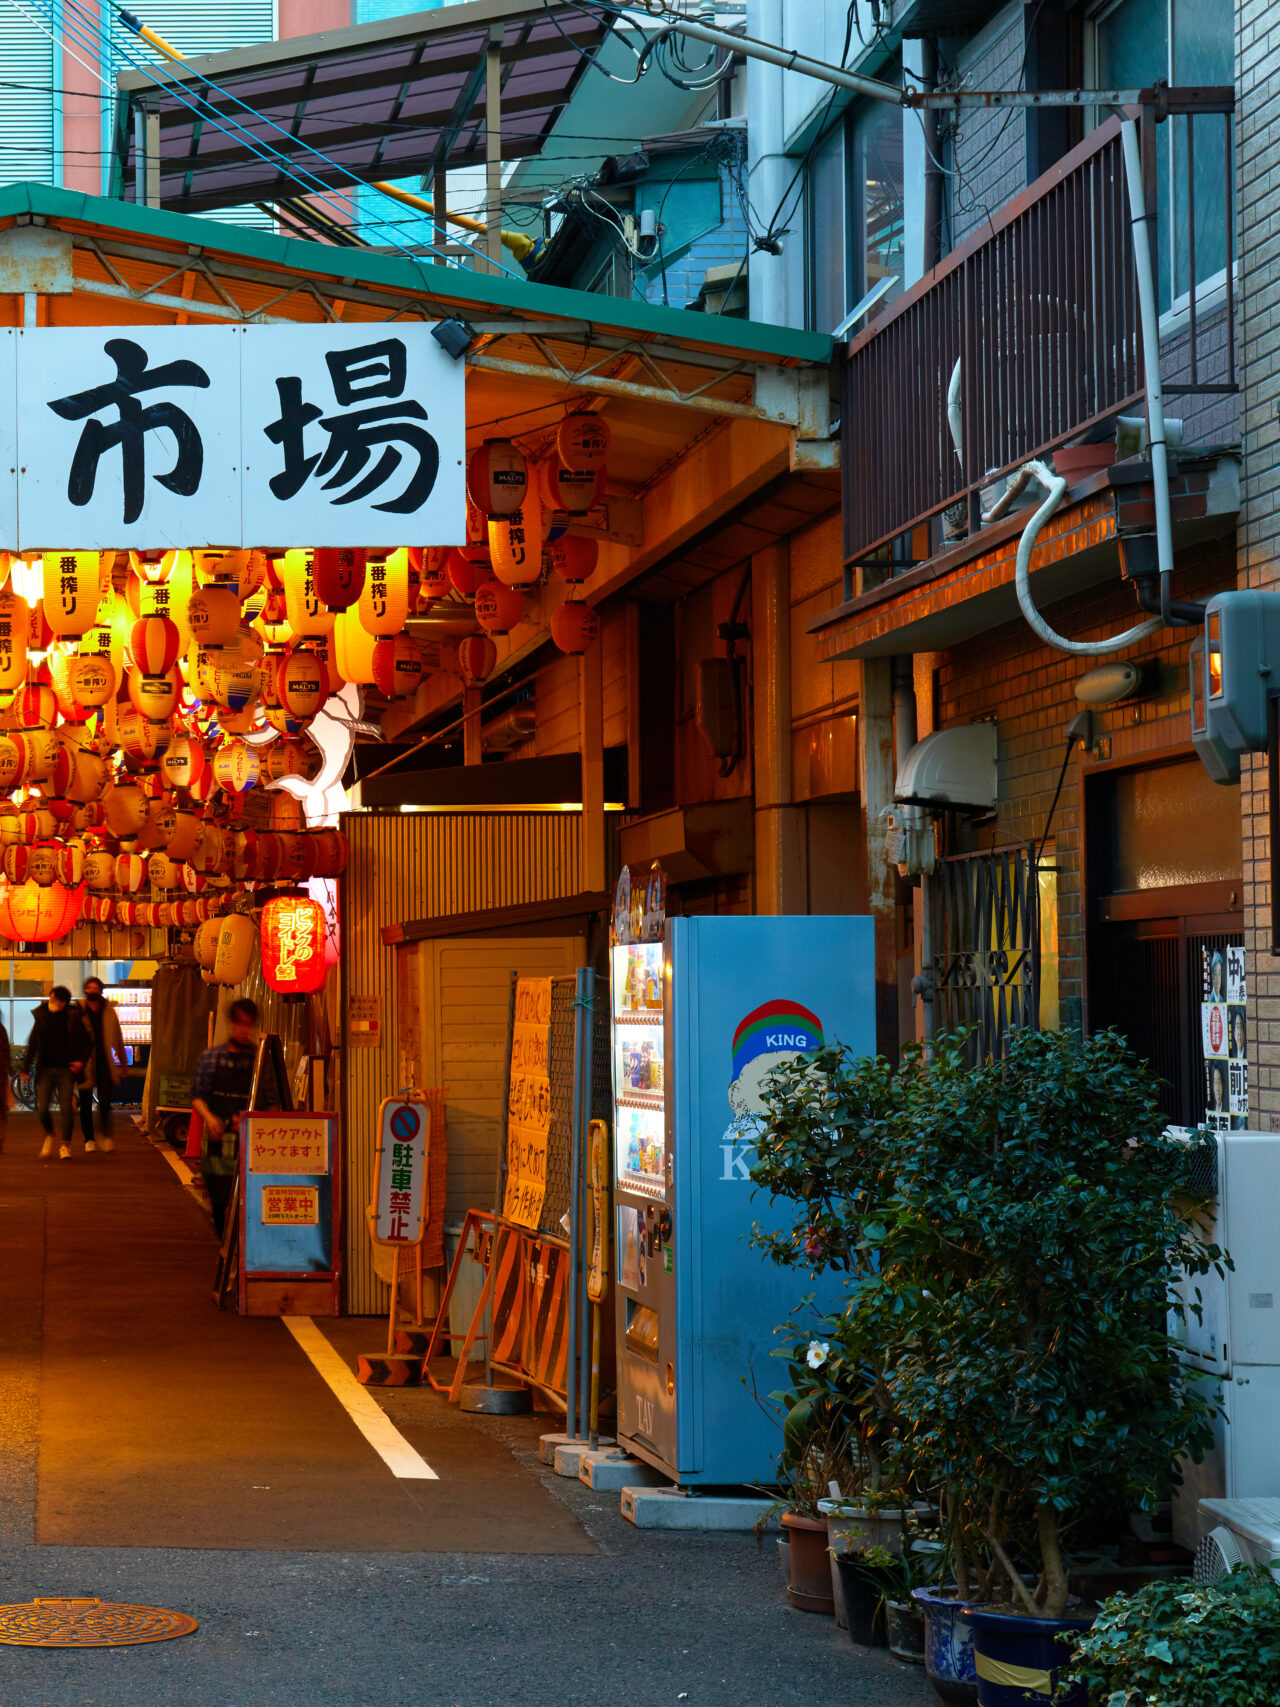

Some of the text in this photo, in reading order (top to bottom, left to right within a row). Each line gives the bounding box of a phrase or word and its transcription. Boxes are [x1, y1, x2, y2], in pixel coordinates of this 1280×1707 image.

[76, 678, 107, 687] 一番搾り
[295, 908, 313, 961] ピンクの
[766, 1033, 807, 1047] KING
[256, 1128, 322, 1140] テイクアウト
[254, 1145, 321, 1158] やってます！
[387, 1143, 414, 1241] 駐車禁止
[267, 1197, 313, 1213] 営業中
